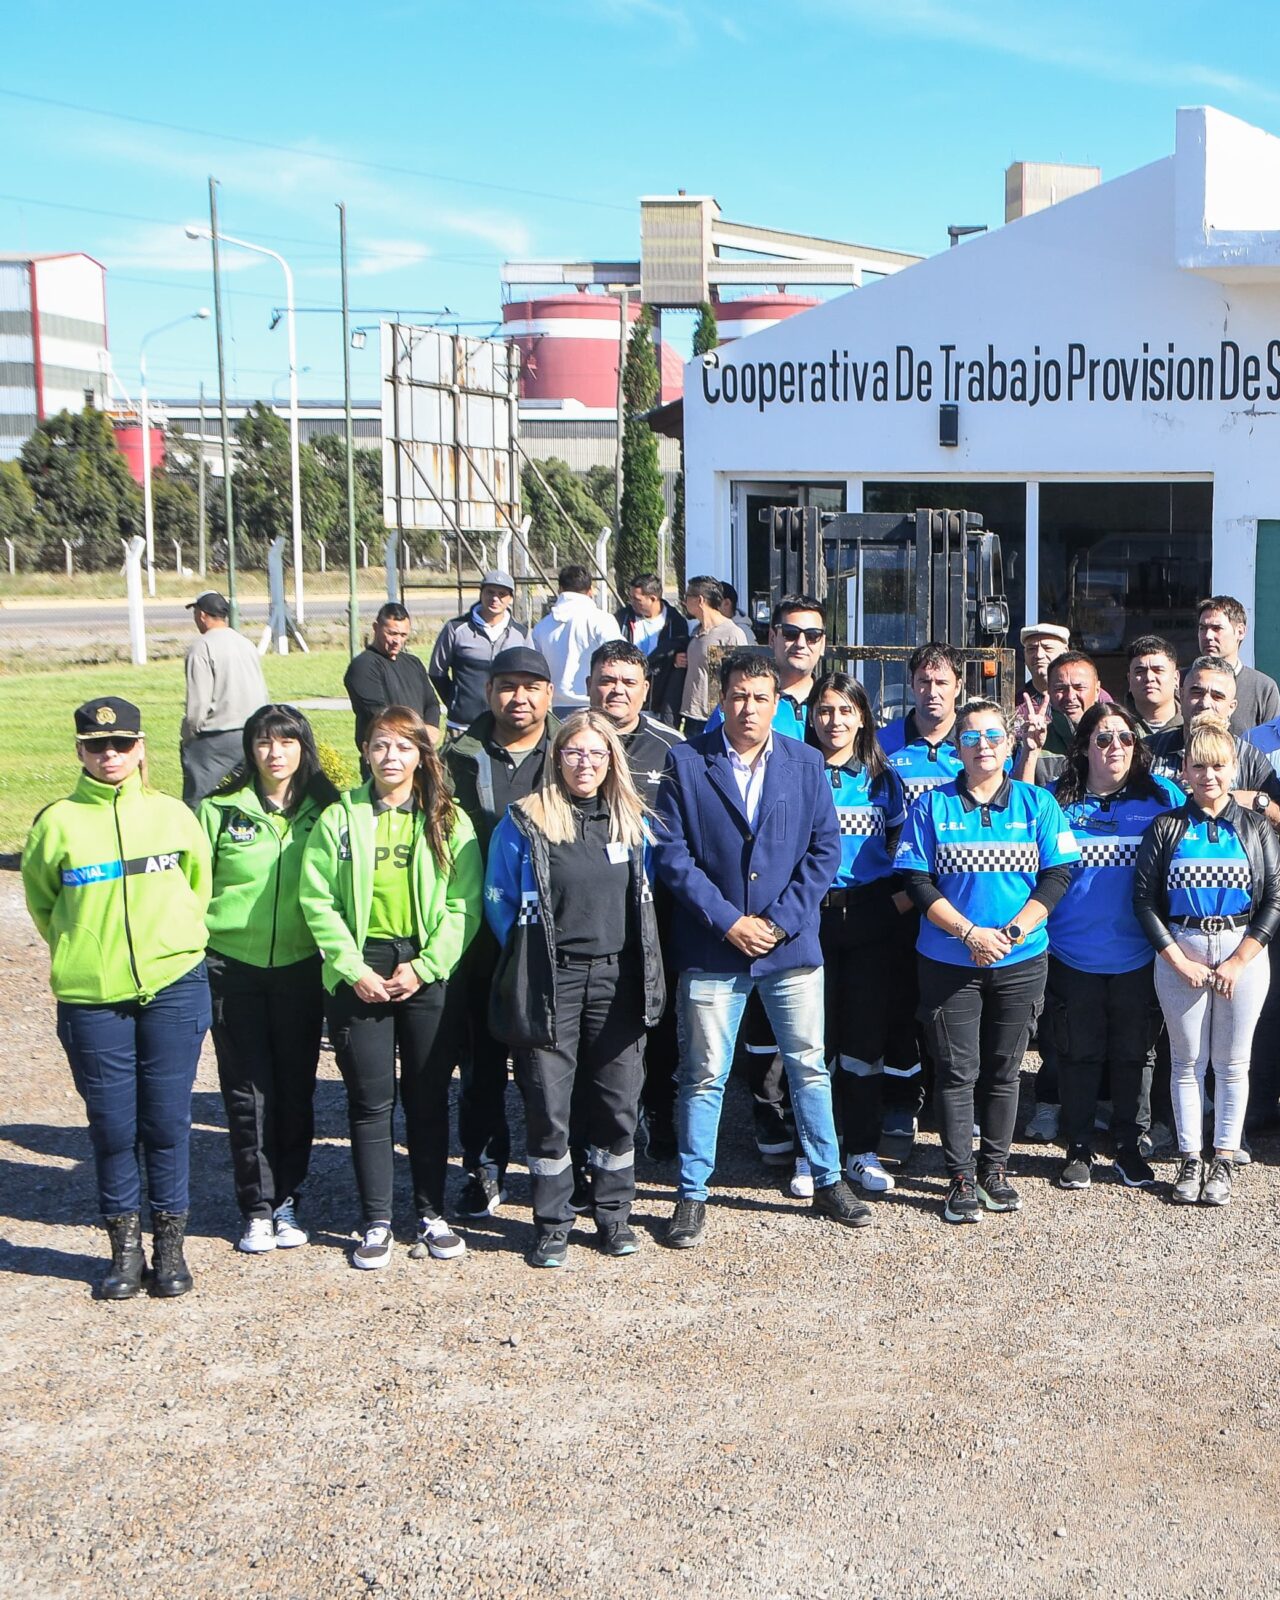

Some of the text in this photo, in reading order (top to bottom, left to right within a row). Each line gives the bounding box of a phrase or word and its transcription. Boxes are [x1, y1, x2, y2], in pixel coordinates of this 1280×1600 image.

[702, 350, 888, 412] Cooperativa
[896, 345, 932, 402] De
[939, 344, 1061, 407] Trabajo
[1067, 343, 1214, 402] Provision
[1220, 340, 1261, 400] De
[375, 843, 411, 871] PS
